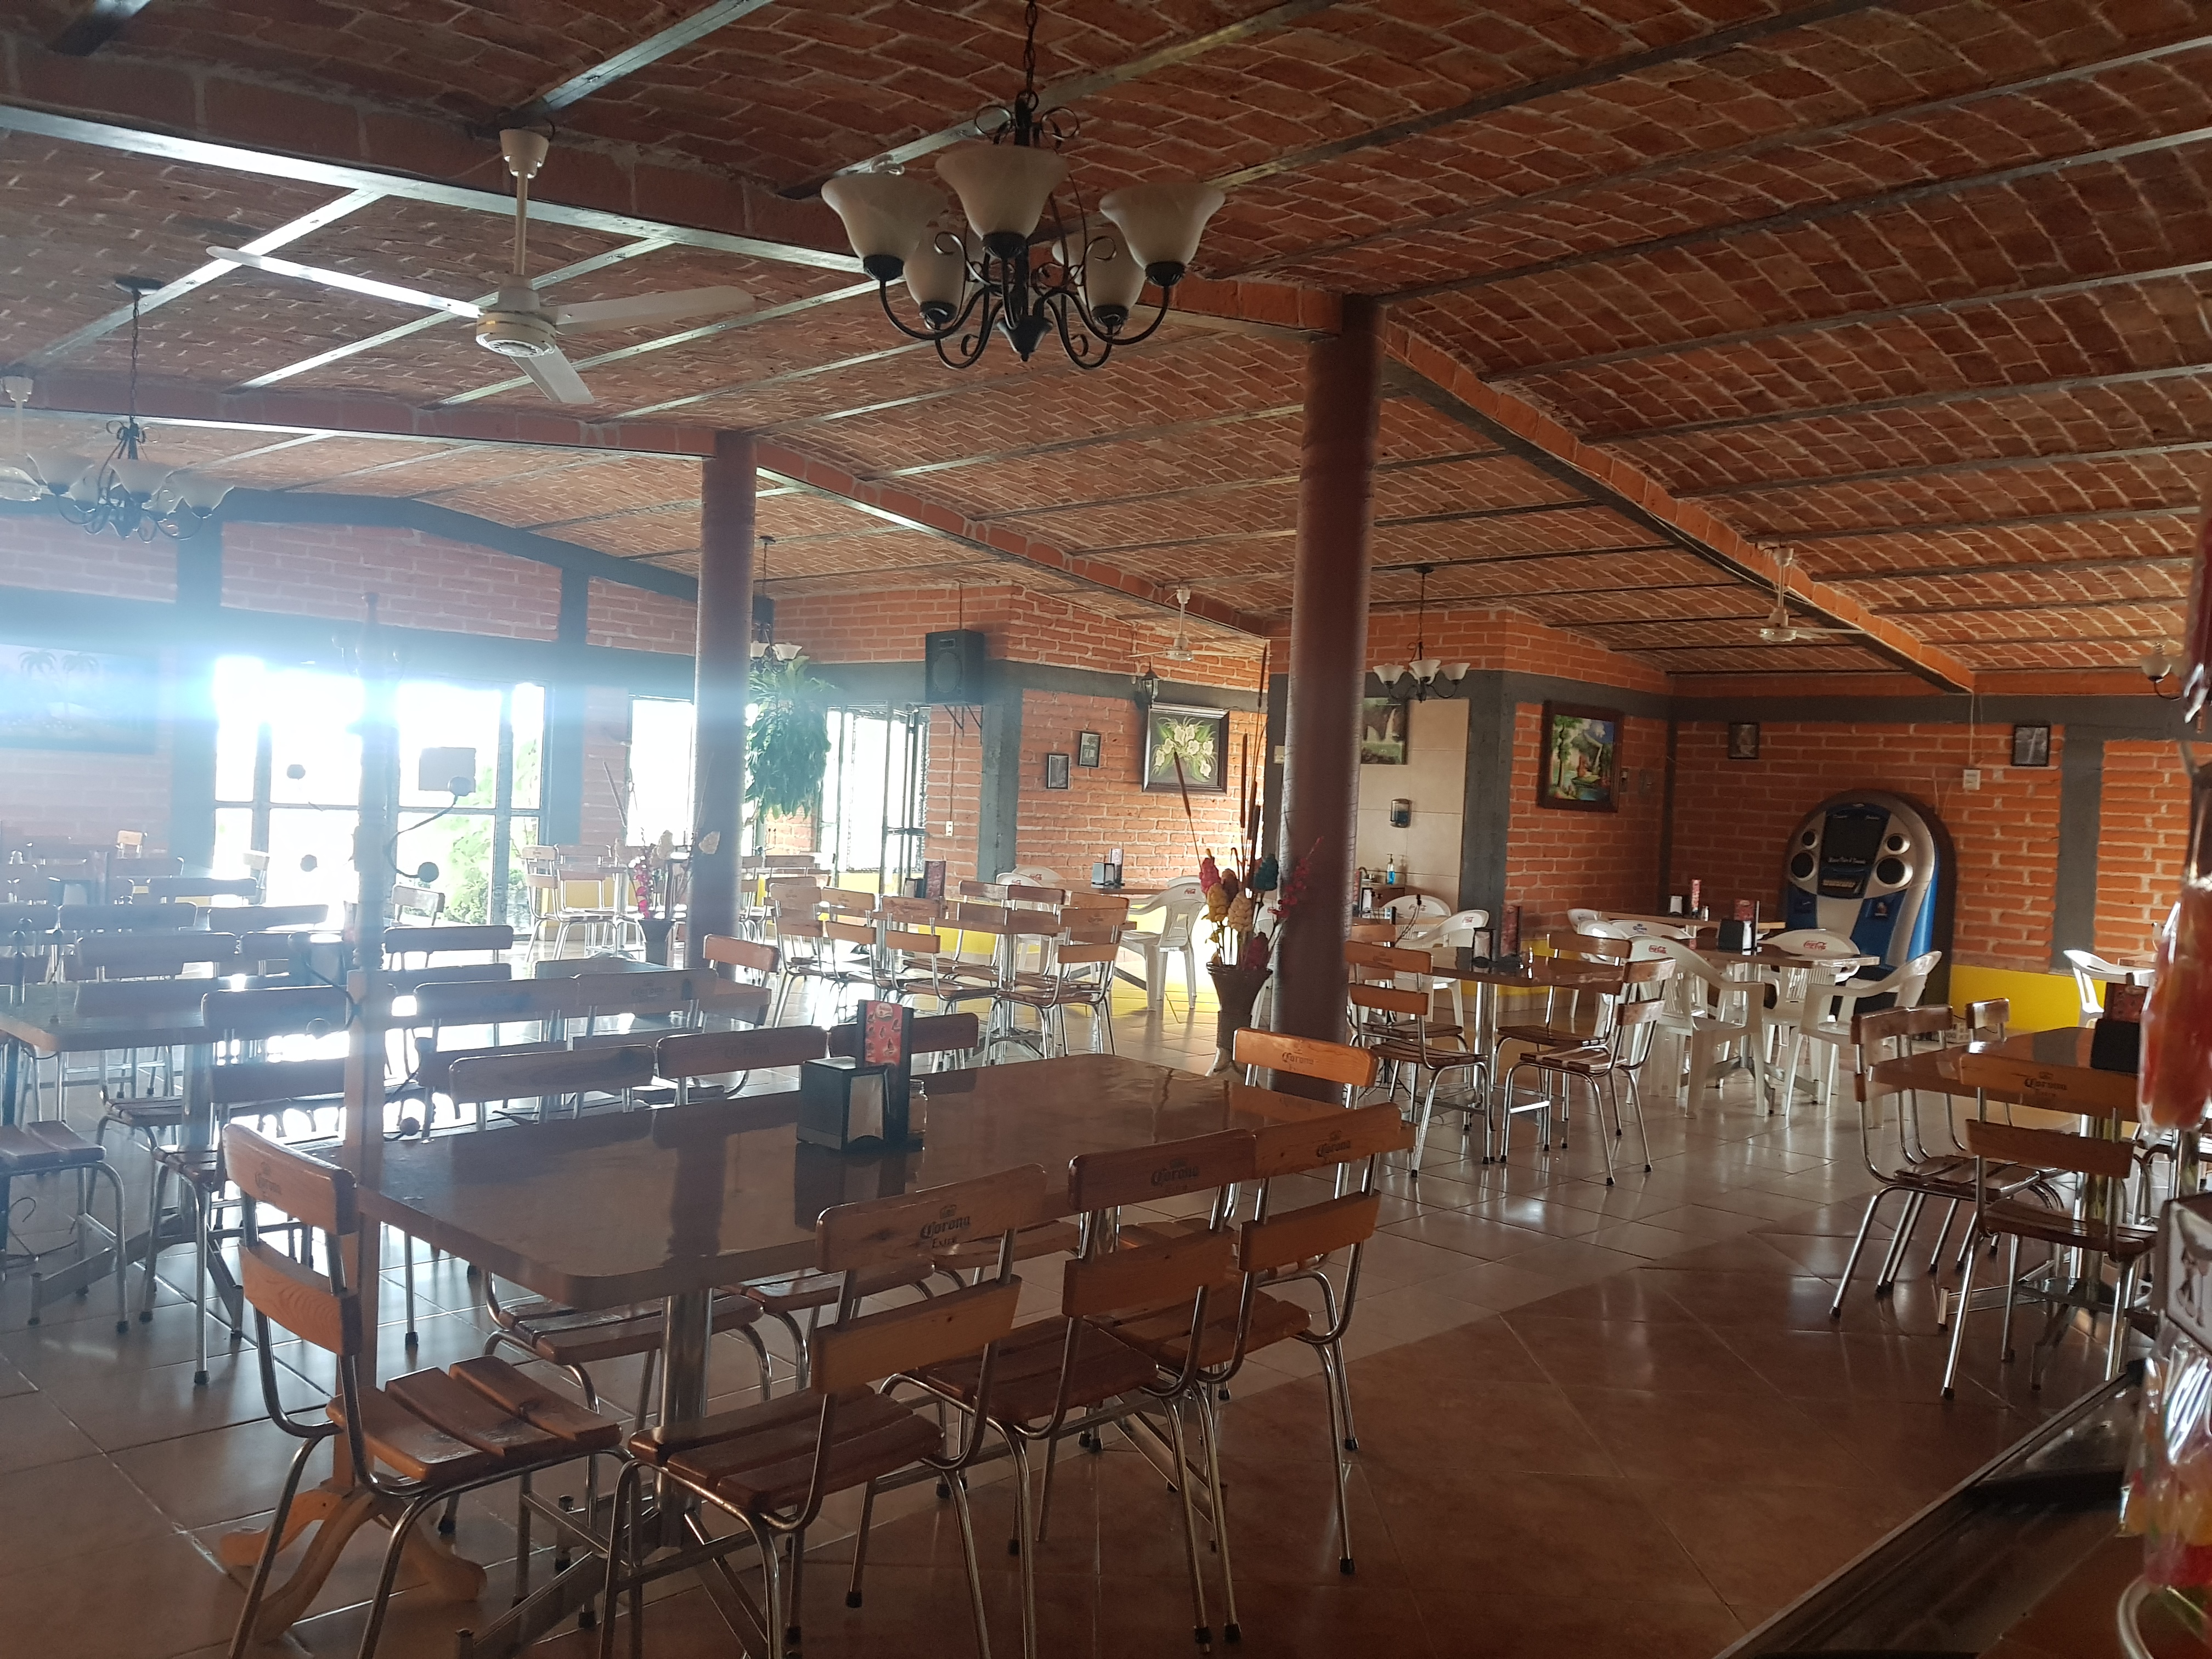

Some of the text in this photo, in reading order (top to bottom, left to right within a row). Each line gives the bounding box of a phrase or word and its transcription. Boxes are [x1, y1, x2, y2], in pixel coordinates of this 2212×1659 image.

[1282, 1052, 1314, 1065] Corona
[1151, 1166, 1199, 1187] Corona
[919, 1216, 970, 1240] Corona
